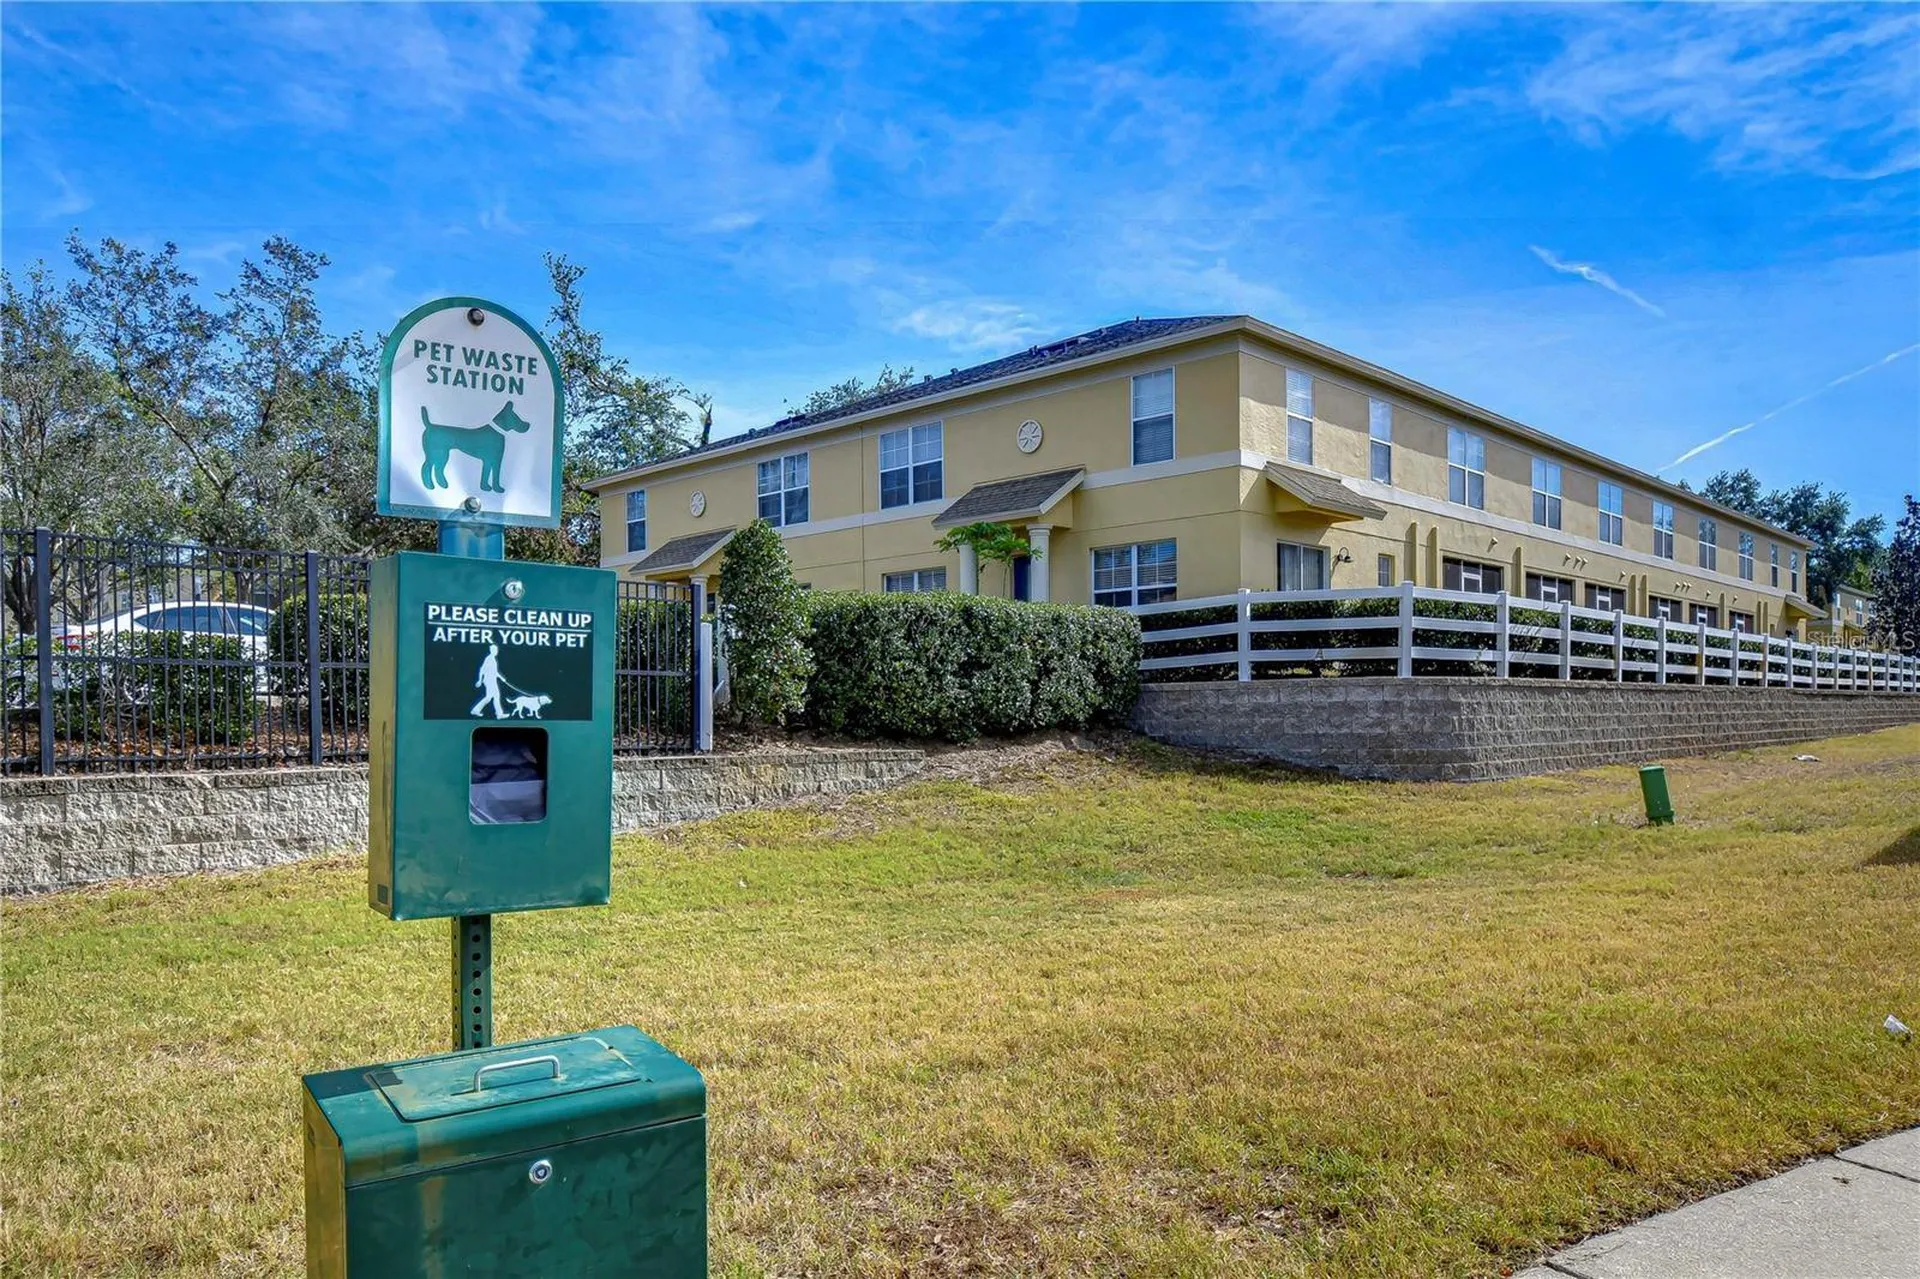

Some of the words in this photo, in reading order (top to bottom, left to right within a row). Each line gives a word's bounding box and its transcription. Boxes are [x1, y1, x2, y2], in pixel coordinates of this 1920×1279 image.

[414, 339, 454, 363] PET
[462, 347, 538, 376] WASTE
[426, 364, 525, 396] STATION
[428, 604, 499, 623] PLEASE
[503, 609, 562, 627] CLEAN
[568, 613, 592, 628] UP
[433, 626, 494, 644] AFTER
[500, 629, 551, 647] YOUR
[555, 632, 588, 648] PET
